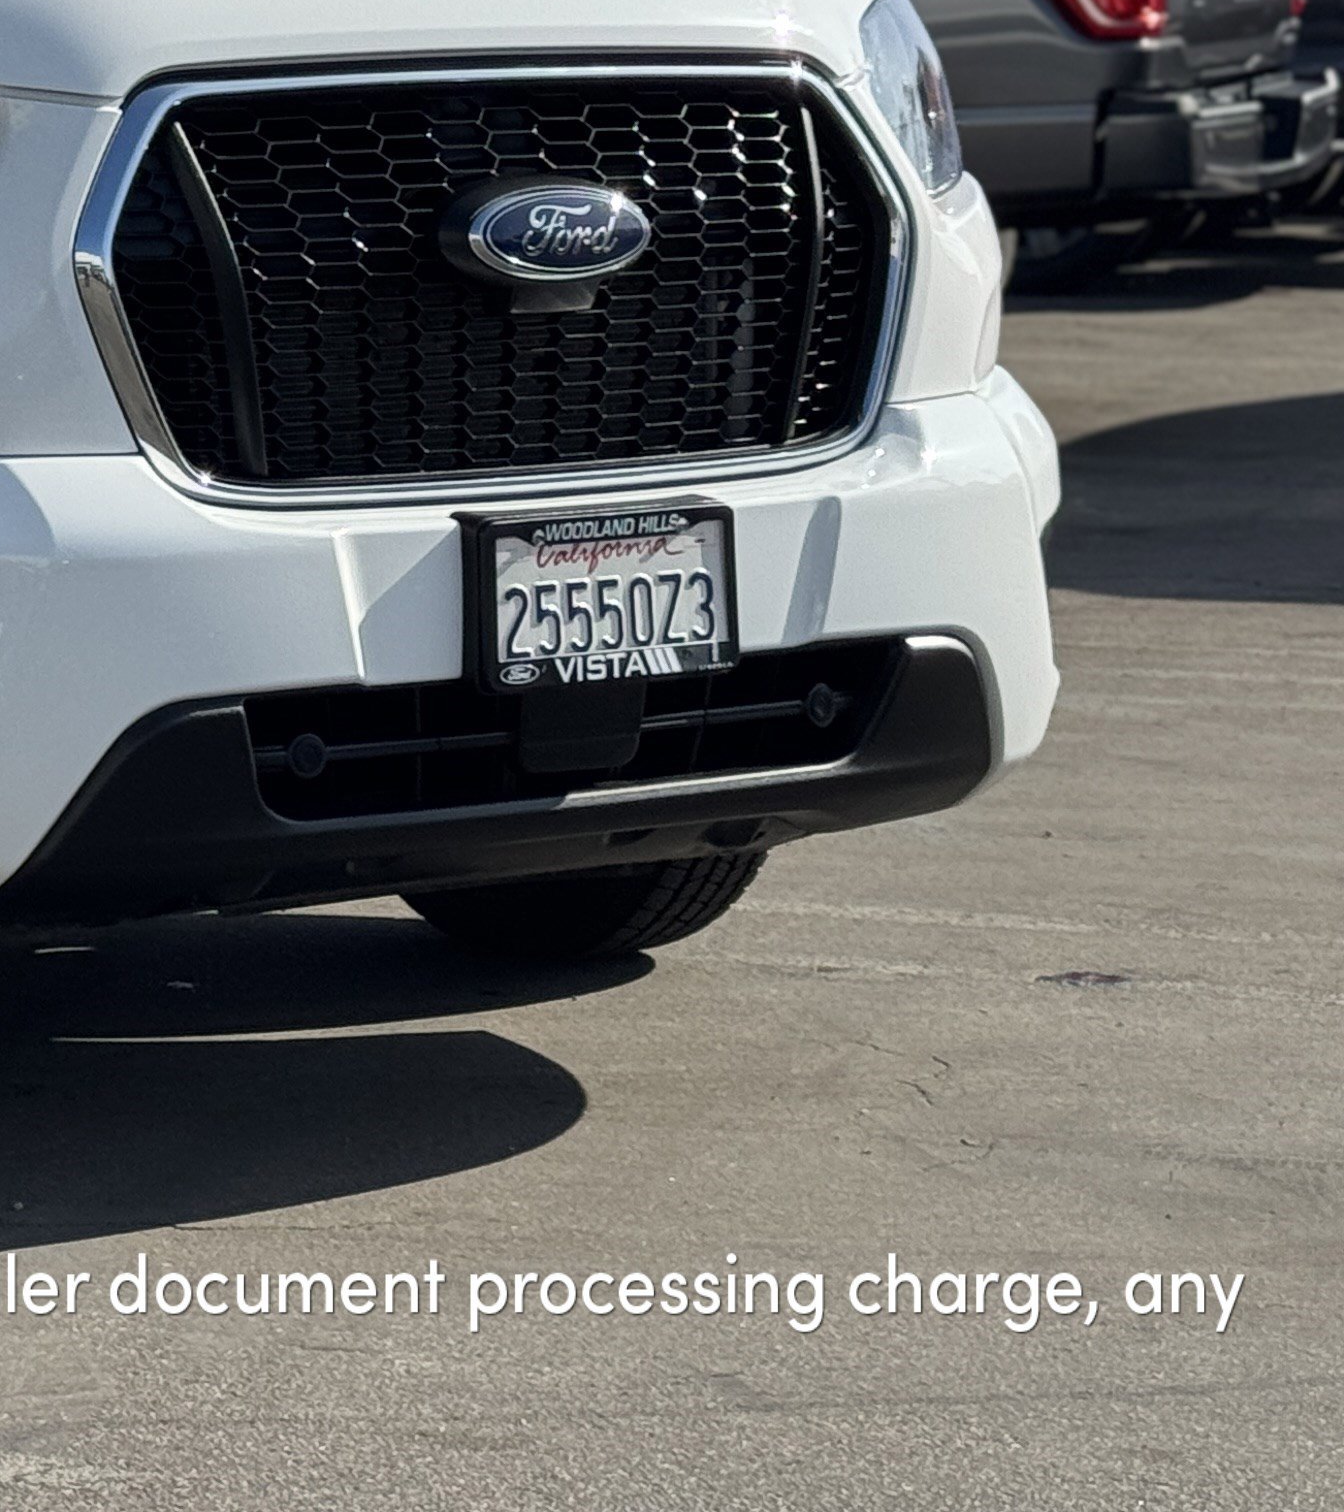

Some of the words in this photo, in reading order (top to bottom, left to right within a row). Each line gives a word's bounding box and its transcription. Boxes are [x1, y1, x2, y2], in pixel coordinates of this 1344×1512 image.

[521, 203, 619, 258] Ford
[546, 519, 636, 542] WOODLAND
[638, 513, 679, 535] HILLS
[534, 538, 684, 574] California
[504, 571, 715, 660] 25550Z3
[554, 650, 648, 684] VISTA
